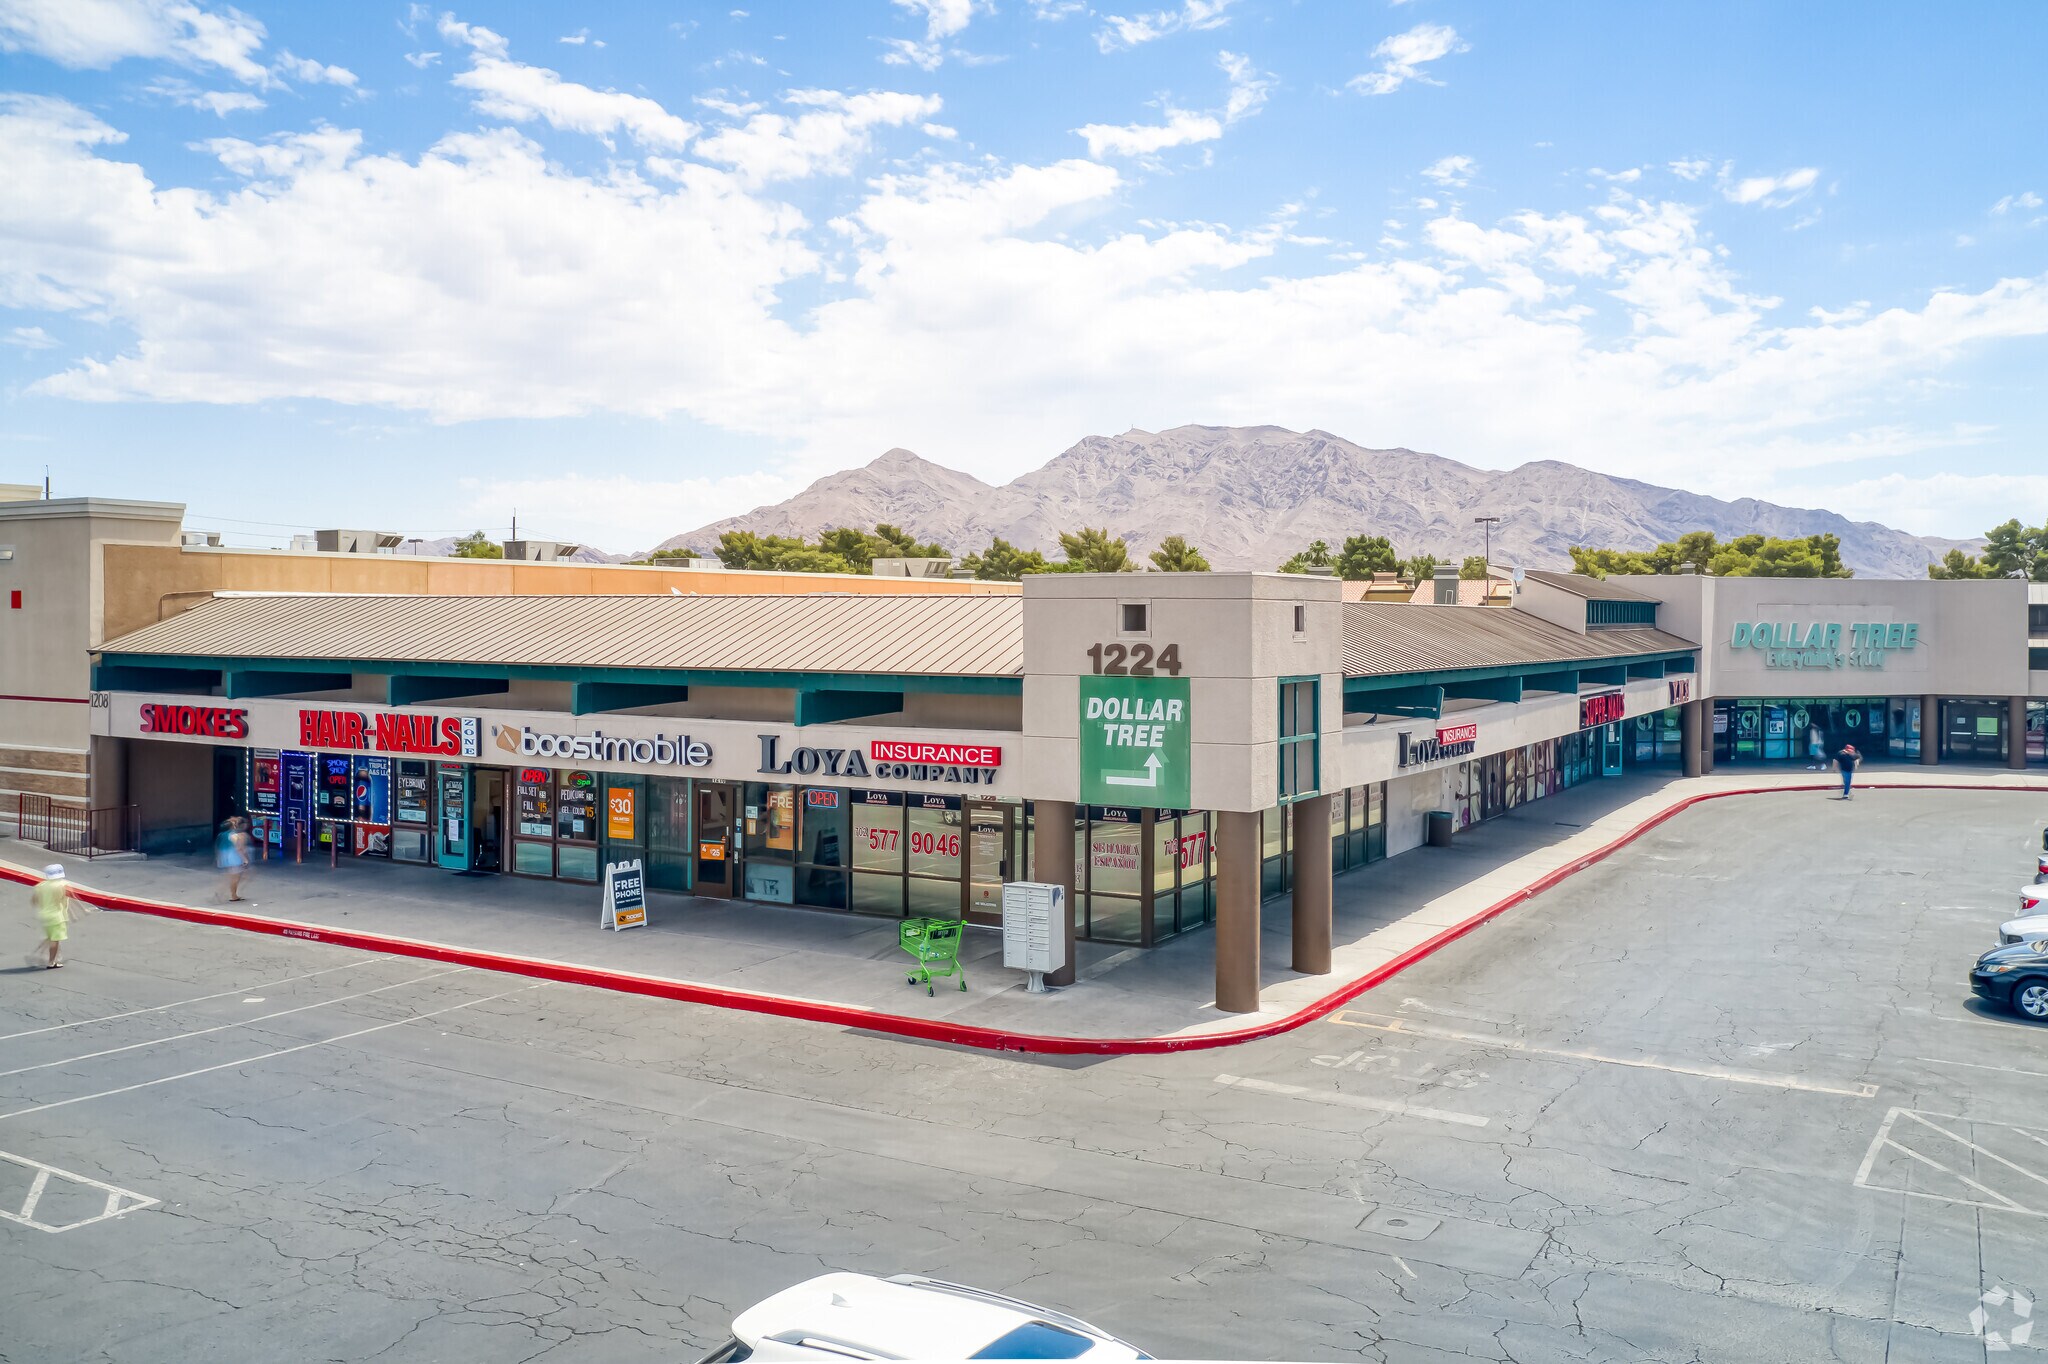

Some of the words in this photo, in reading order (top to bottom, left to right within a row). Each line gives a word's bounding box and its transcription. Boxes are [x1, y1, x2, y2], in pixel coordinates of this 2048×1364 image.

[1730, 622, 1842, 649] DOLLAR
[1850, 623, 1919, 649] TREE
[1086, 643, 1181, 675] 1224
[90, 693, 109, 708] 1208
[1086, 697, 1183, 721] DOLLAR
[140, 704, 249, 738] SMOKES
[299, 710, 462, 757] HAIR-NAILS
[464, 719, 475, 755] ZONE
[1103, 724, 1165, 747] TREE
[1443, 726, 1475, 742] INSURANCE
[757, 735, 871, 777] LOYA
[874, 744, 993, 763] INSURANCE
[1398, 731, 1440, 768] LOYA
[327, 759, 348, 768] SMOKE
[329, 776, 347, 784] OPEN
[521, 769, 547, 784] OPEN
[875, 763, 997, 785] COMPANY
[398, 777, 426, 790] EYEBROWS
[577, 779, 591, 787] Spa
[517, 786, 528, 796] FULL
[529, 787, 537, 797] SET
[561, 789, 585, 800] PEDICURE
[809, 790, 837, 806] OPEN
[867, 791, 887, 800] LOYA
[523, 801, 534, 811] FILL
[610, 798, 631, 814] $30
[923, 795, 945, 804] LOYA
[1103, 808, 1127, 817] LOYA
[1160, 808, 1171, 816] LOYA
[978, 825, 995, 833] LOYA
[869, 828, 900, 851] 577
[911, 831, 960, 857] 9046
[1181, 831, 1206, 869] 577
[614, 877, 640, 891] FREE
[615, 888, 641, 899] PHONE
